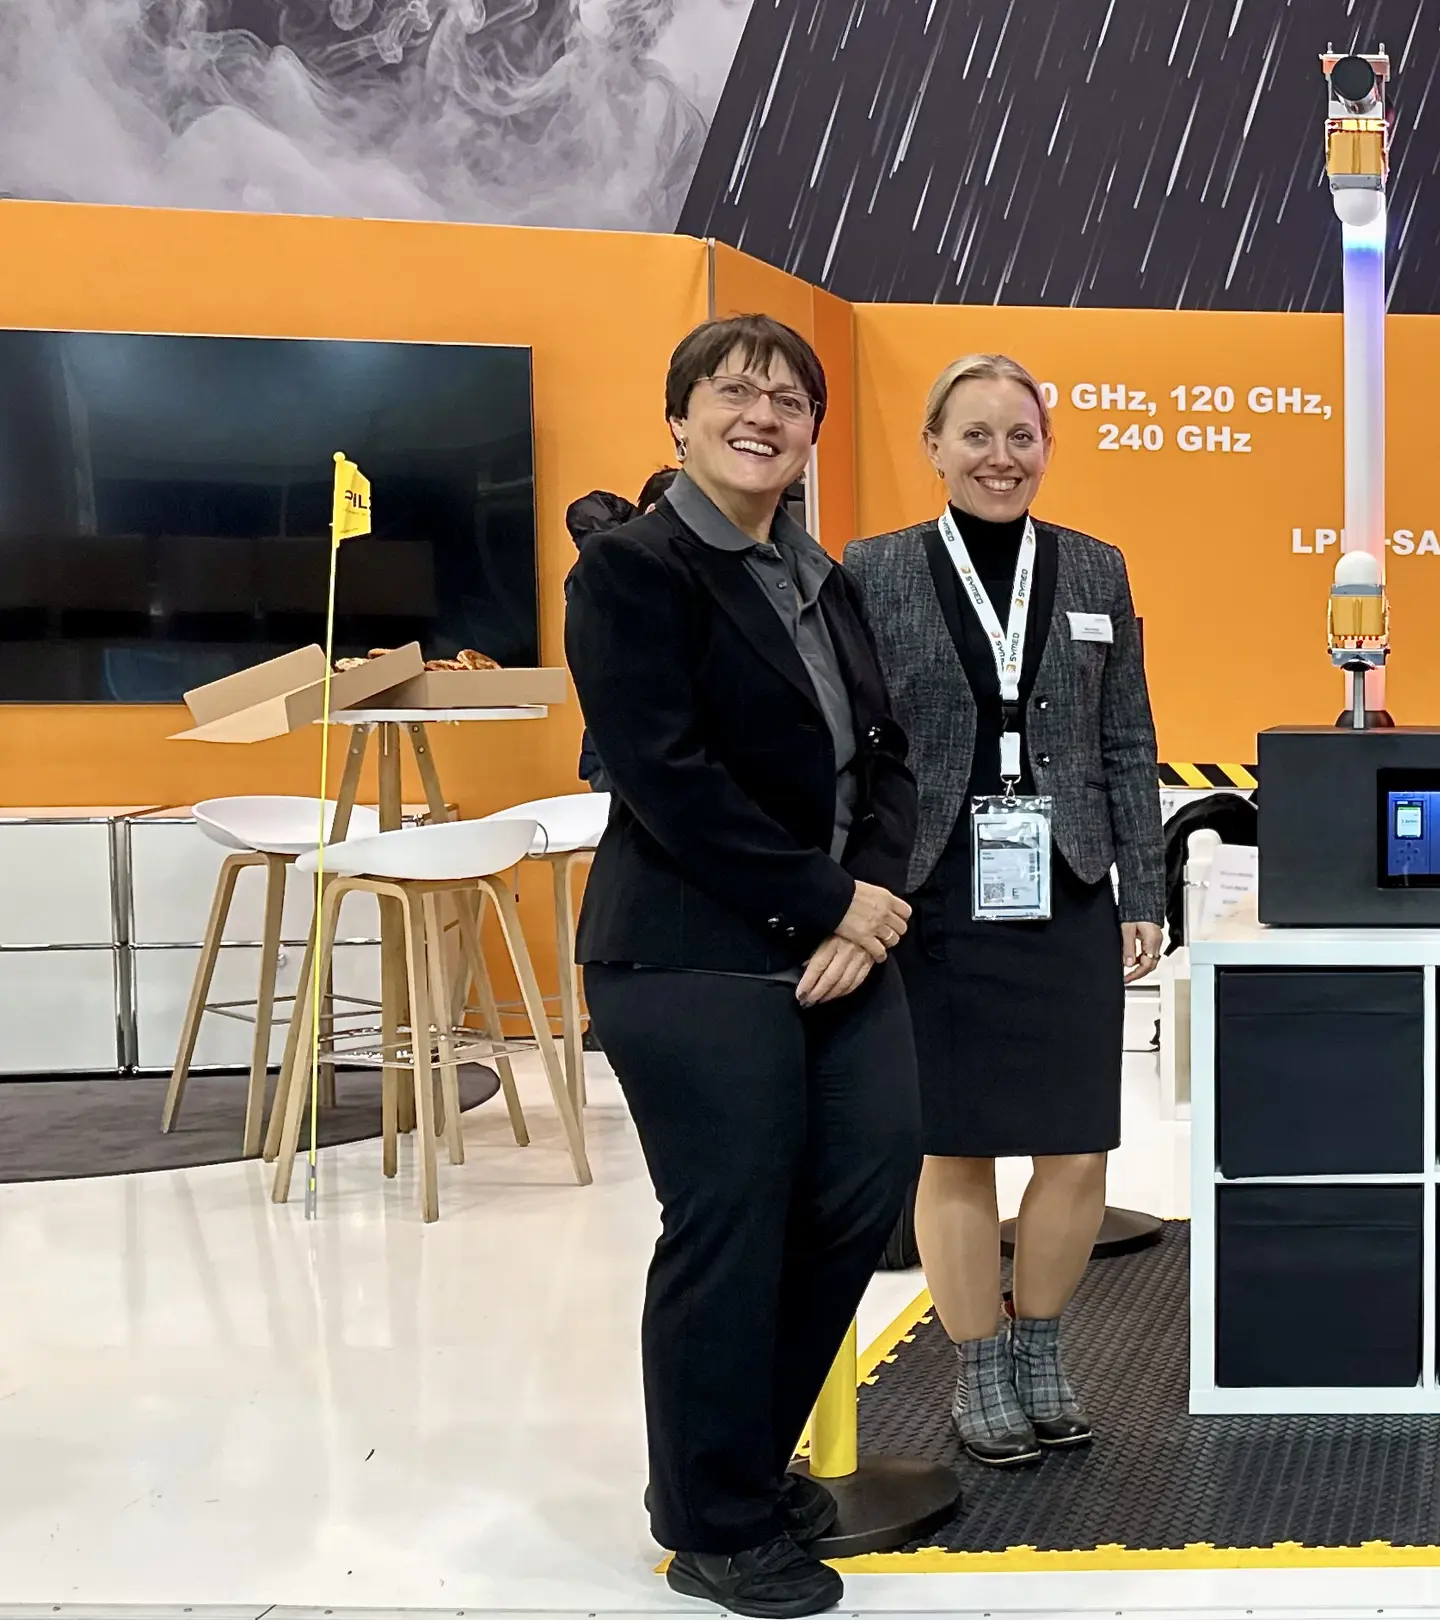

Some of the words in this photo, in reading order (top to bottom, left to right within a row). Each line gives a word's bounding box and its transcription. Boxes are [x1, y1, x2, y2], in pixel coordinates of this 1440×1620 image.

[1038, 382, 1059, 409] 0
[1071, 383, 1157, 418] GHz,
[1170, 385, 1235, 412] 120
[1248, 386, 1333, 420] GHz,
[1098, 424, 1164, 451] 240
[1176, 425, 1252, 453] GHz
[345, 490, 371, 509] PIL
